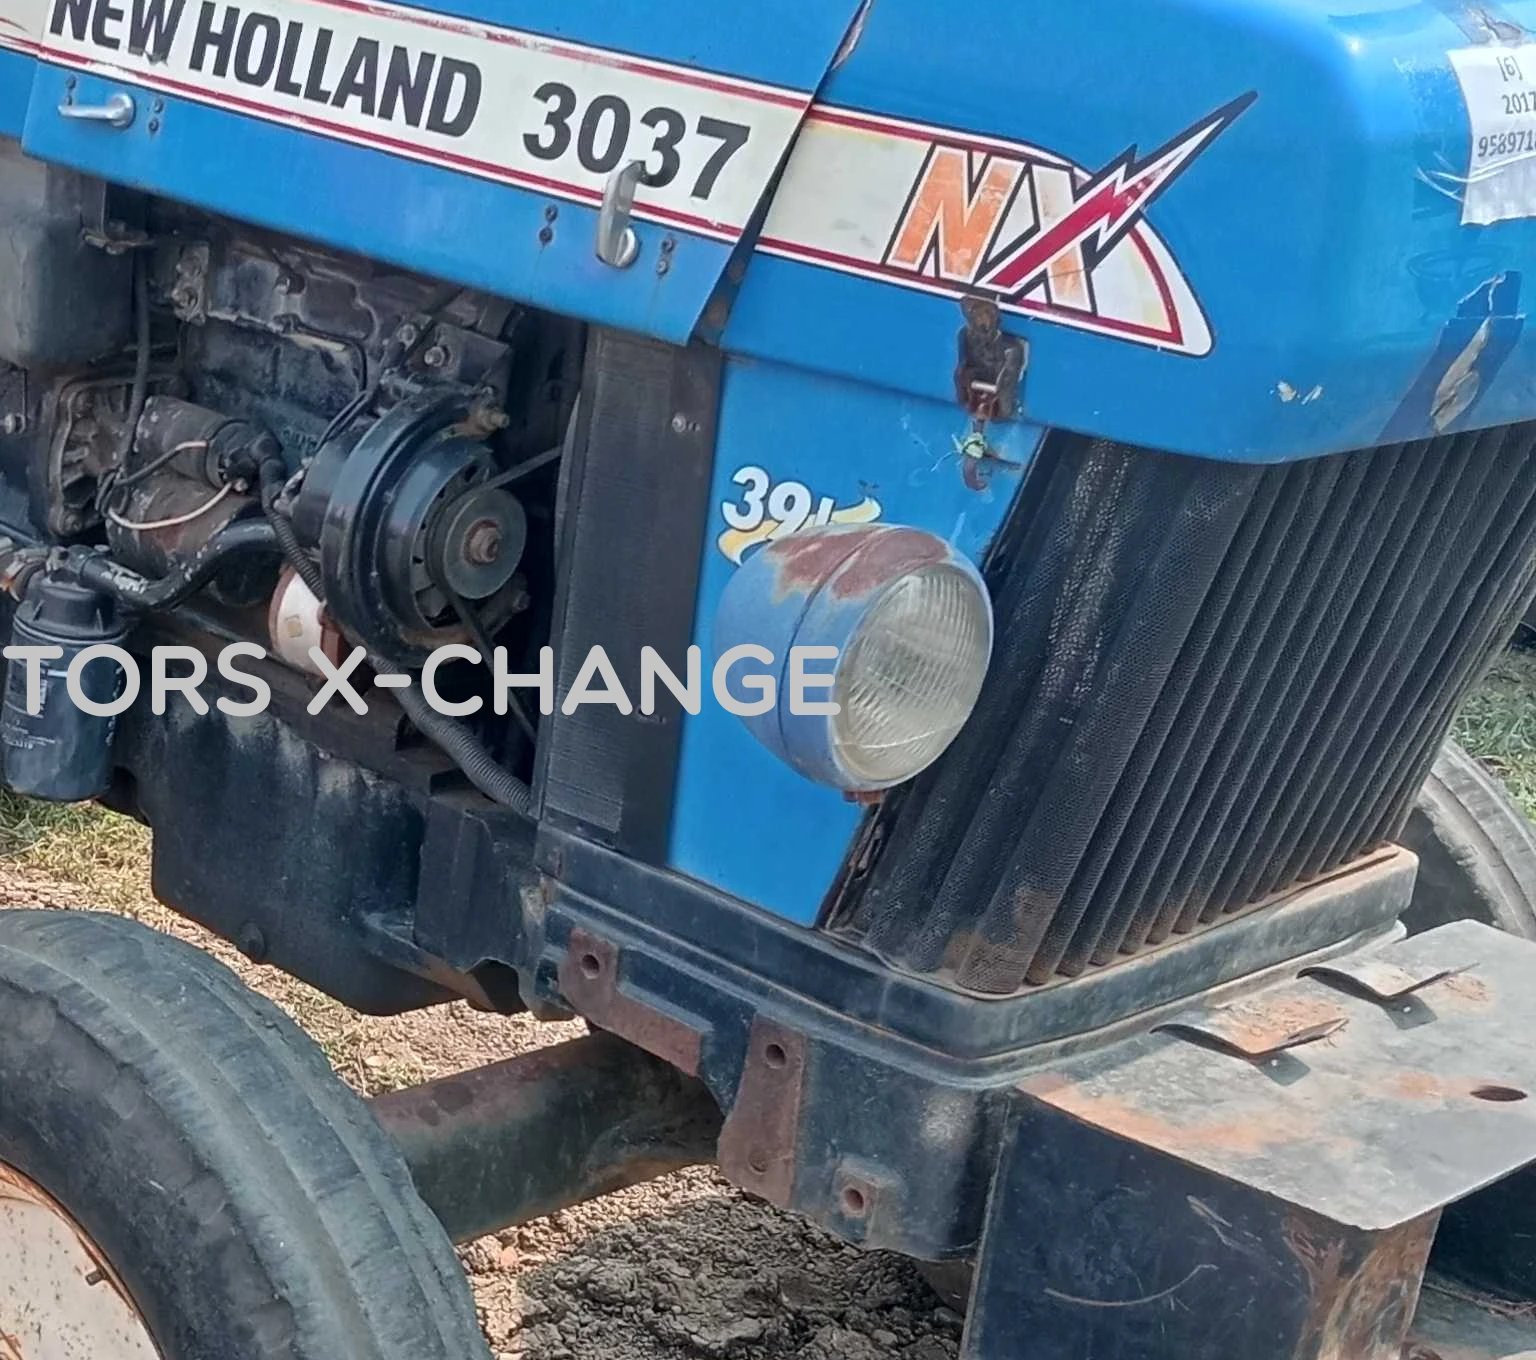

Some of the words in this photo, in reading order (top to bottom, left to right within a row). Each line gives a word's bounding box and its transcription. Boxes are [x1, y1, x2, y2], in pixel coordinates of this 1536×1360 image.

[189, 0, 482, 138] HOLLAND
[522, 81, 750, 201] 3037
[879, 90, 1257, 317] NX
[1478, 129, 1536, 158] 958971
